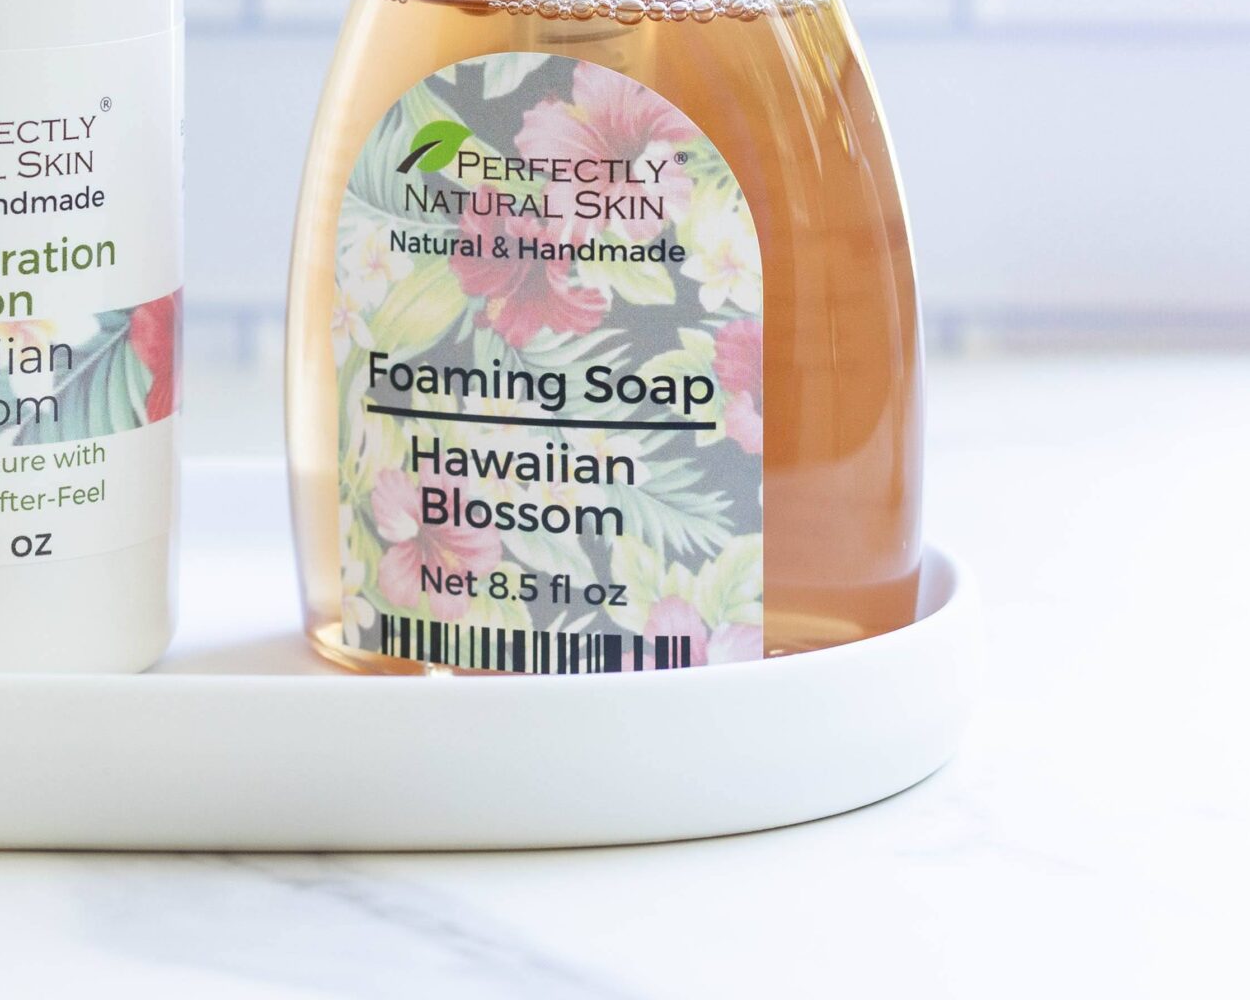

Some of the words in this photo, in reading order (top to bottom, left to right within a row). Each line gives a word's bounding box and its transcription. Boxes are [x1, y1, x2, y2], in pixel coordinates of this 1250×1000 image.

[18, 151, 93, 178] SKIN
[457, 151, 667, 184] PERFECTLY
[405, 184, 563, 219] NATURAL
[575, 191, 663, 219] SKIN
[391, 230, 481, 257] Natural
[492, 236, 509, 259] &
[519, 237, 685, 263] Handmade
[367, 351, 566, 409] Foaming
[584, 366, 714, 414] Soap
[54, 443, 105, 468] with
[412, 436, 634, 485] Hawaiian
[422, 487, 623, 536] Blossom
[11, 533, 52, 557] oz
[421, 565, 478, 597] Net
[489, 572, 538, 602] 8.5
[550, 574, 571, 604] fl
[586, 584, 627, 607] oz
